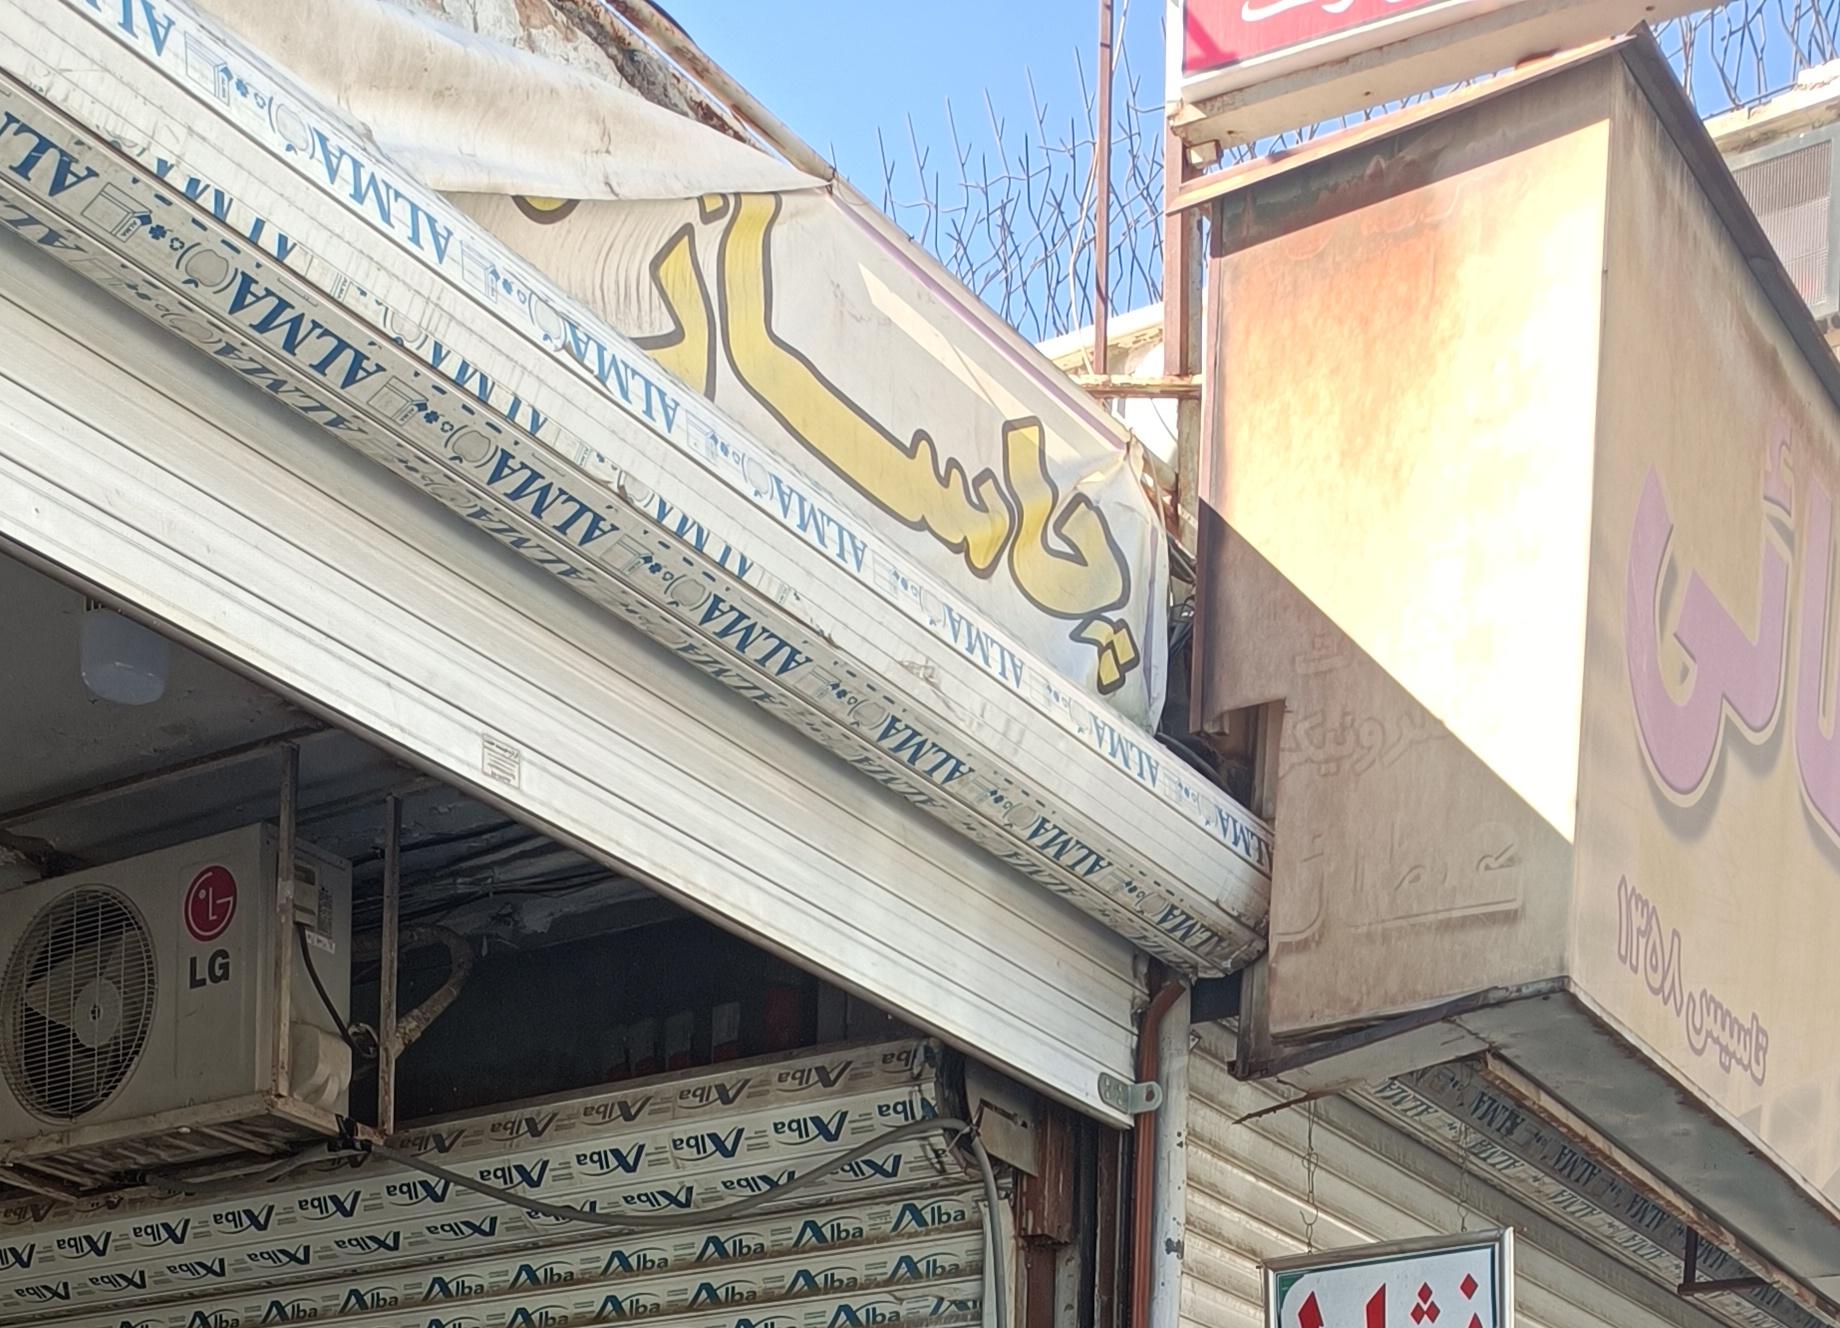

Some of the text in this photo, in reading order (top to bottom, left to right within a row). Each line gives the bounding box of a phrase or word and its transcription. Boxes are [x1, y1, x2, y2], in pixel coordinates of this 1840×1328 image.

[0, 110, 99, 197] AL
[227, 269, 386, 391] ALMA
[485, 447, 620, 549] ALMA
[700, 592, 813, 677] ALMA
[876, 713, 975, 786] ALMA
[1027, 815, 1113, 878] ALMA
[313, 127, 454, 265] ALMA
[566, 322, 681, 434] ALMA
[769, 472, 868, 573] ALMA
[942, 603, 1025, 690] ALMA
[1088, 710, 1161, 788] ALMA
[1216, 807, 1273, 868] LMA
[188, 948, 231, 990] LG
[882, 1044, 917, 1073] lba
[15, 1281, 71, 1302] Alba
[89, 1270, 145, 1291] Alba
[167, 1257, 226, 1279] Alba
[247, 1245, 311, 1267] Alba
[334, 1231, 400, 1254] Alba
[425, 1216, 498, 1240] Alba
[622, 1185, 693, 1211] Alba
[56, 1231, 112, 1258] Alba
[132, 1218, 191, 1246] Alba
[212, 1204, 275, 1233] Alba
[298, 1189, 361, 1219] Alba
[386, 1178, 450, 1206] Alba
[479, 1159, 549, 1190] Alba
[576, 1143, 646, 1175] Alba
[672, 1127, 745, 1161] Alba
[773, 1110, 849, 1144] Alba
[261, 1299, 317, 1324] Alba
[339, 1287, 399, 1313] Alba
[423, 1275, 484, 1301] Alba
[509, 1262, 574, 1290] Alba
[602, 1249, 669, 1276] Alba
[695, 1233, 764, 1262] Alba
[793, 1217, 864, 1248] Alba
[890, 1200, 966, 1232] Alba
[594, 1294, 660, 1321] Alba
[689, 1281, 757, 1309] Alba
[785, 1268, 858, 1296] Alba
[889, 1254, 960, 1282] Alba
